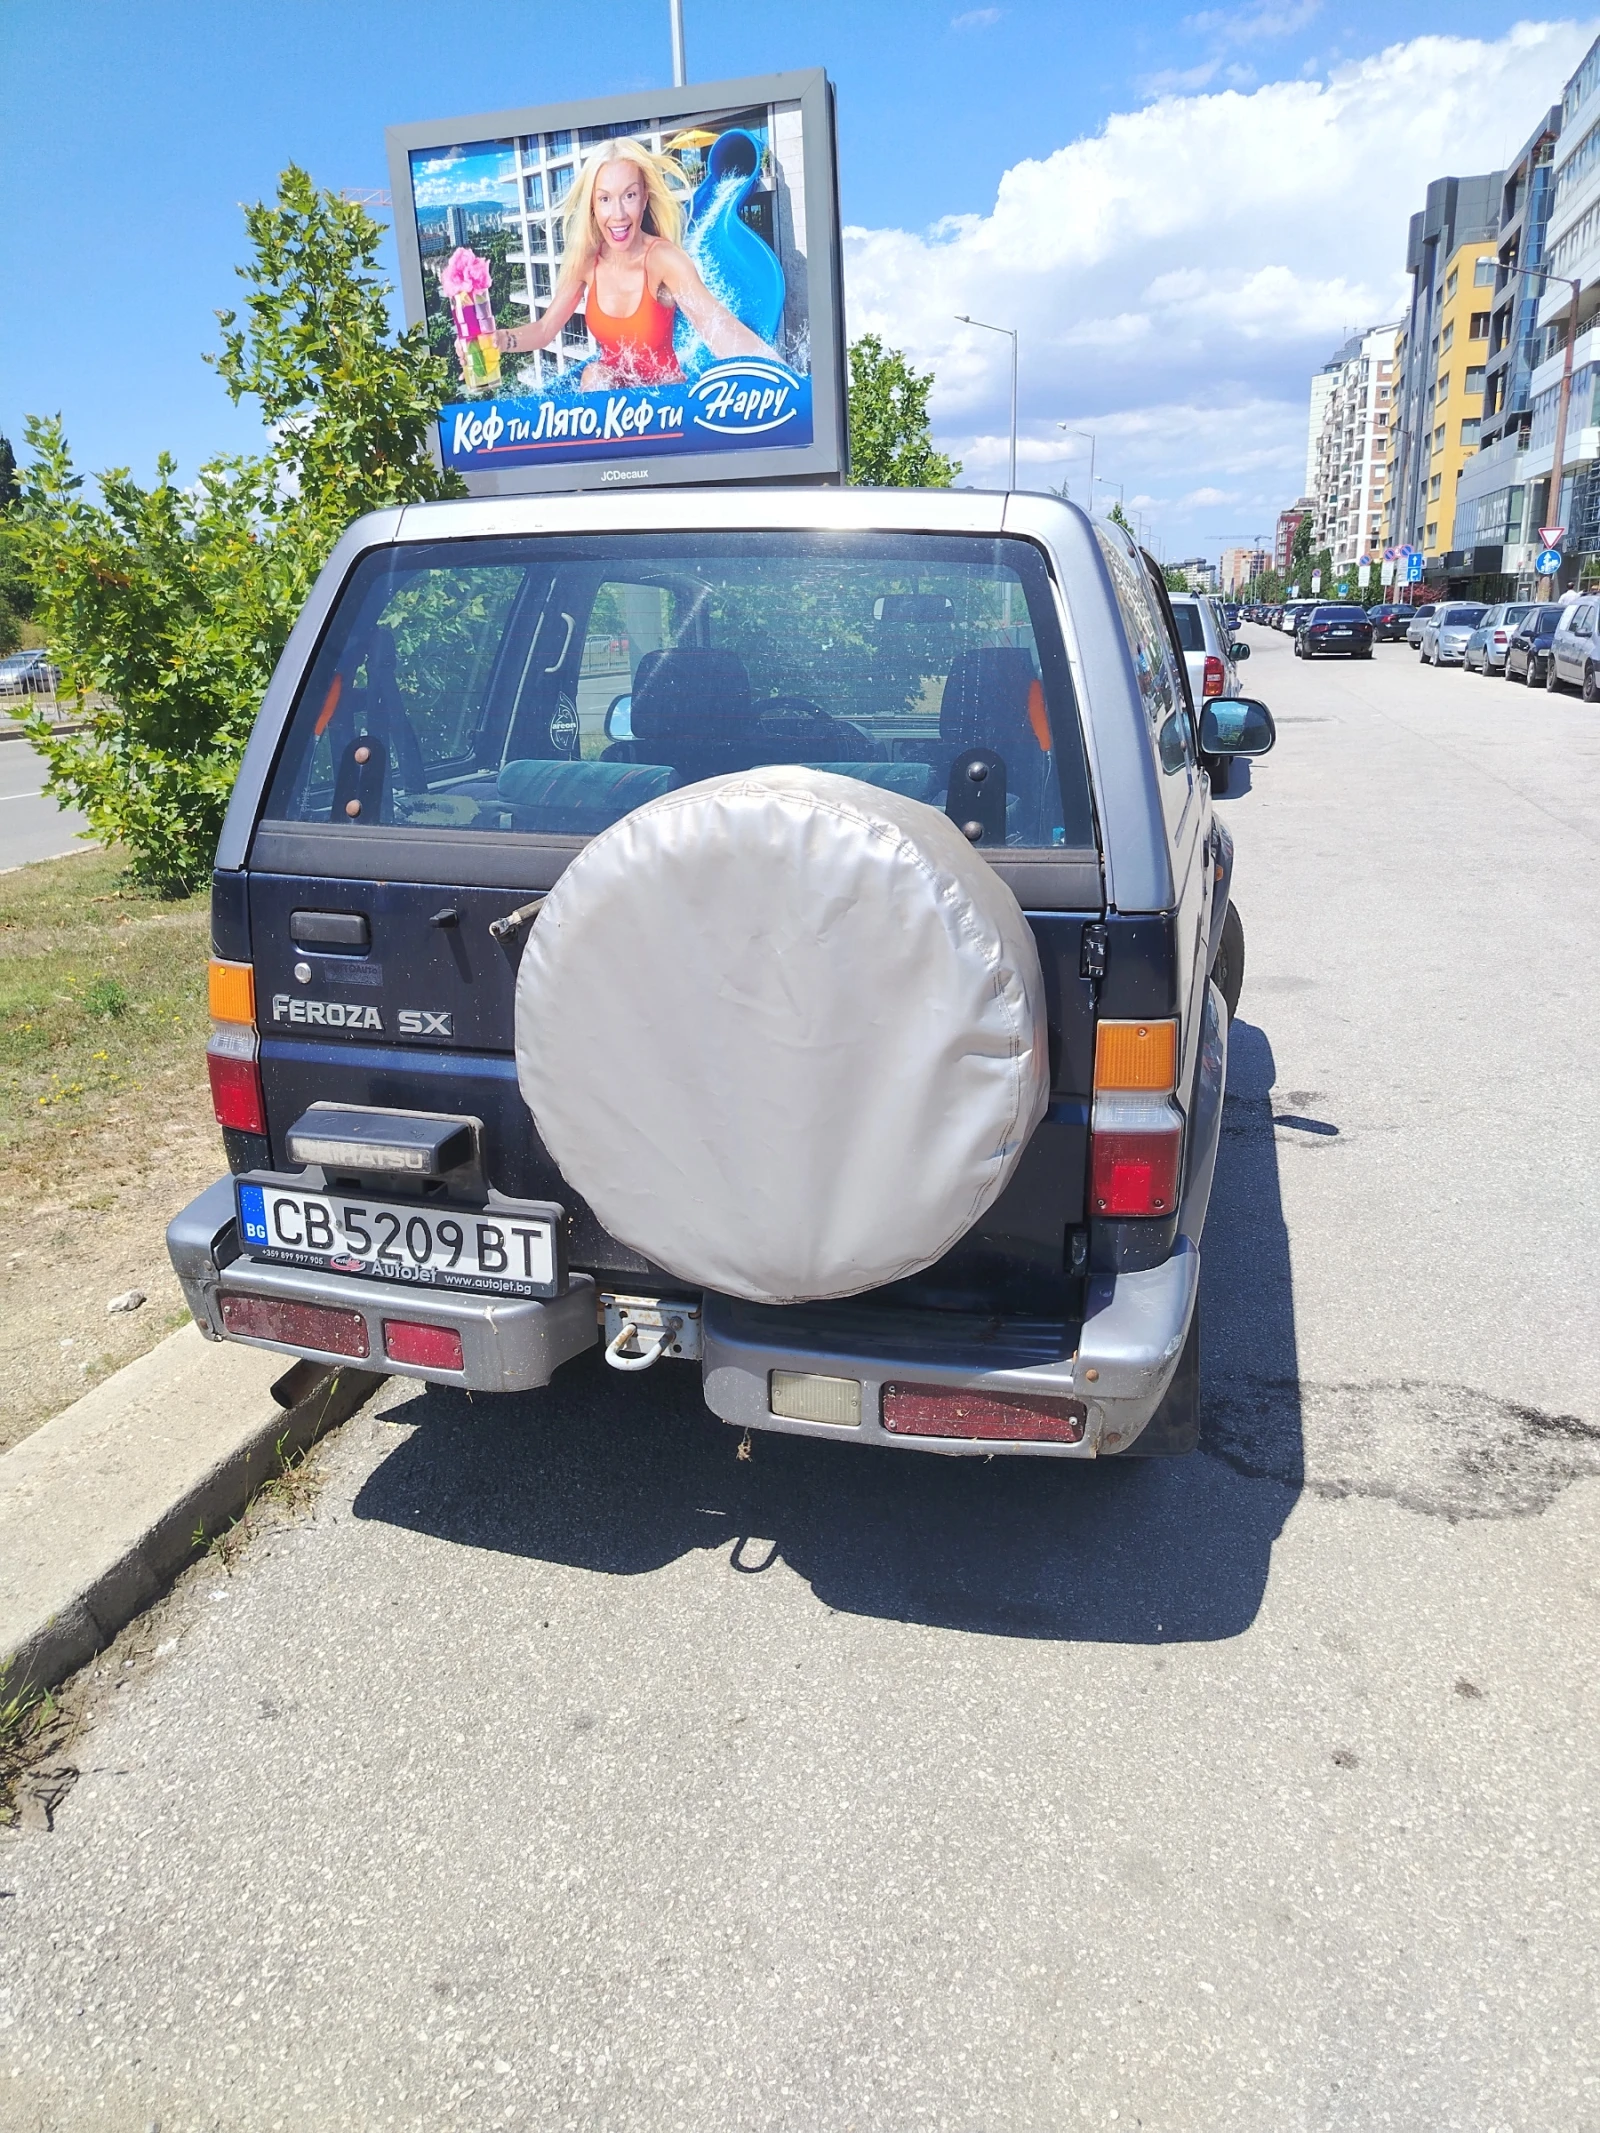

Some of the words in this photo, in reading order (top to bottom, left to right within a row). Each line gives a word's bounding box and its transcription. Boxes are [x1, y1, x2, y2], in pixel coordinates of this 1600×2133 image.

[699, 378, 790, 420] Happy
[453, 407, 501, 455] Кеф
[508, 417, 531, 440] ти
[531, 402, 603, 441] Лято,
[603, 395, 653, 441] Кеф
[657, 405, 684, 429] ти
[600, 470, 649, 482] JCDecaux
[1410, 569, 1419, 580] P
[272, 994, 385, 1030] FEROZA
[398, 1009, 453, 1036] SX
[246, 1222, 265, 1239] BG
[272, 1198, 334, 1250] CB
[343, 1206, 463, 1268] 5209
[476, 1224, 542, 1277] BT
[262, 1249, 278, 1258] +359
[281, 1251, 294, 1260] 899
[295, 1254, 308, 1262] 997
[310, 1256, 323, 1265] 905
[371, 1259, 437, 1283] AutoJet
[444, 1273, 532, 1295] www.autojet.bg
